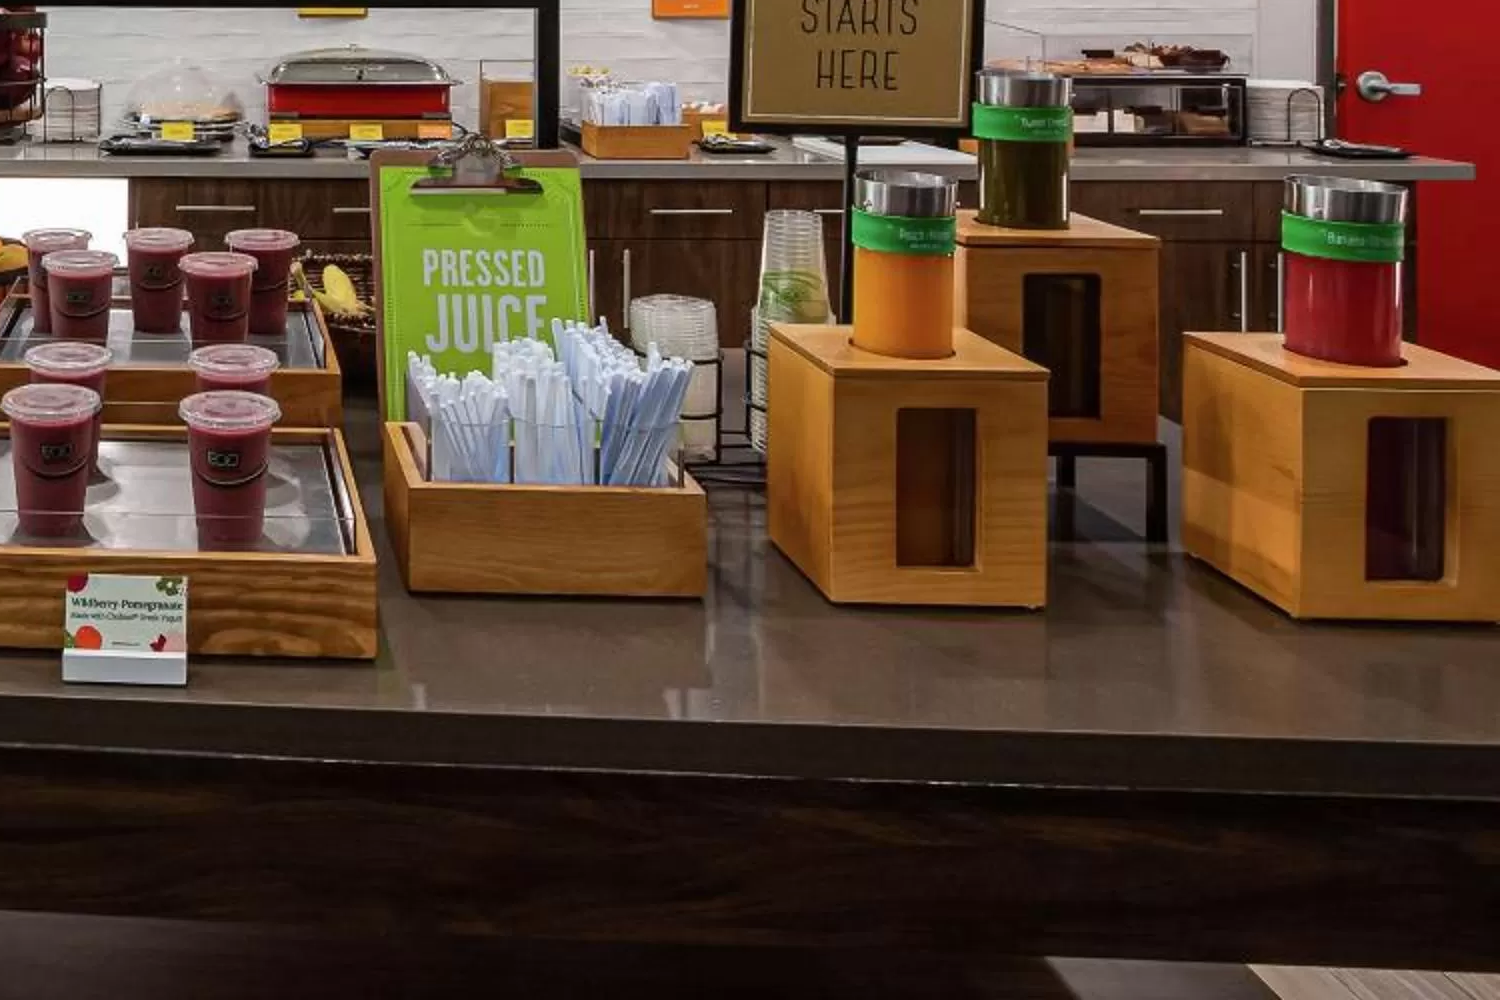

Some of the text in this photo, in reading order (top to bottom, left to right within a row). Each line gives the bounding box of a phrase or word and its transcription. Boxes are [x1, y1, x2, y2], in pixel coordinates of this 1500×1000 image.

[816, 49, 900, 91] HERE
[422, 248, 546, 288] PRESSED
[425, 294, 547, 354] JUICE
